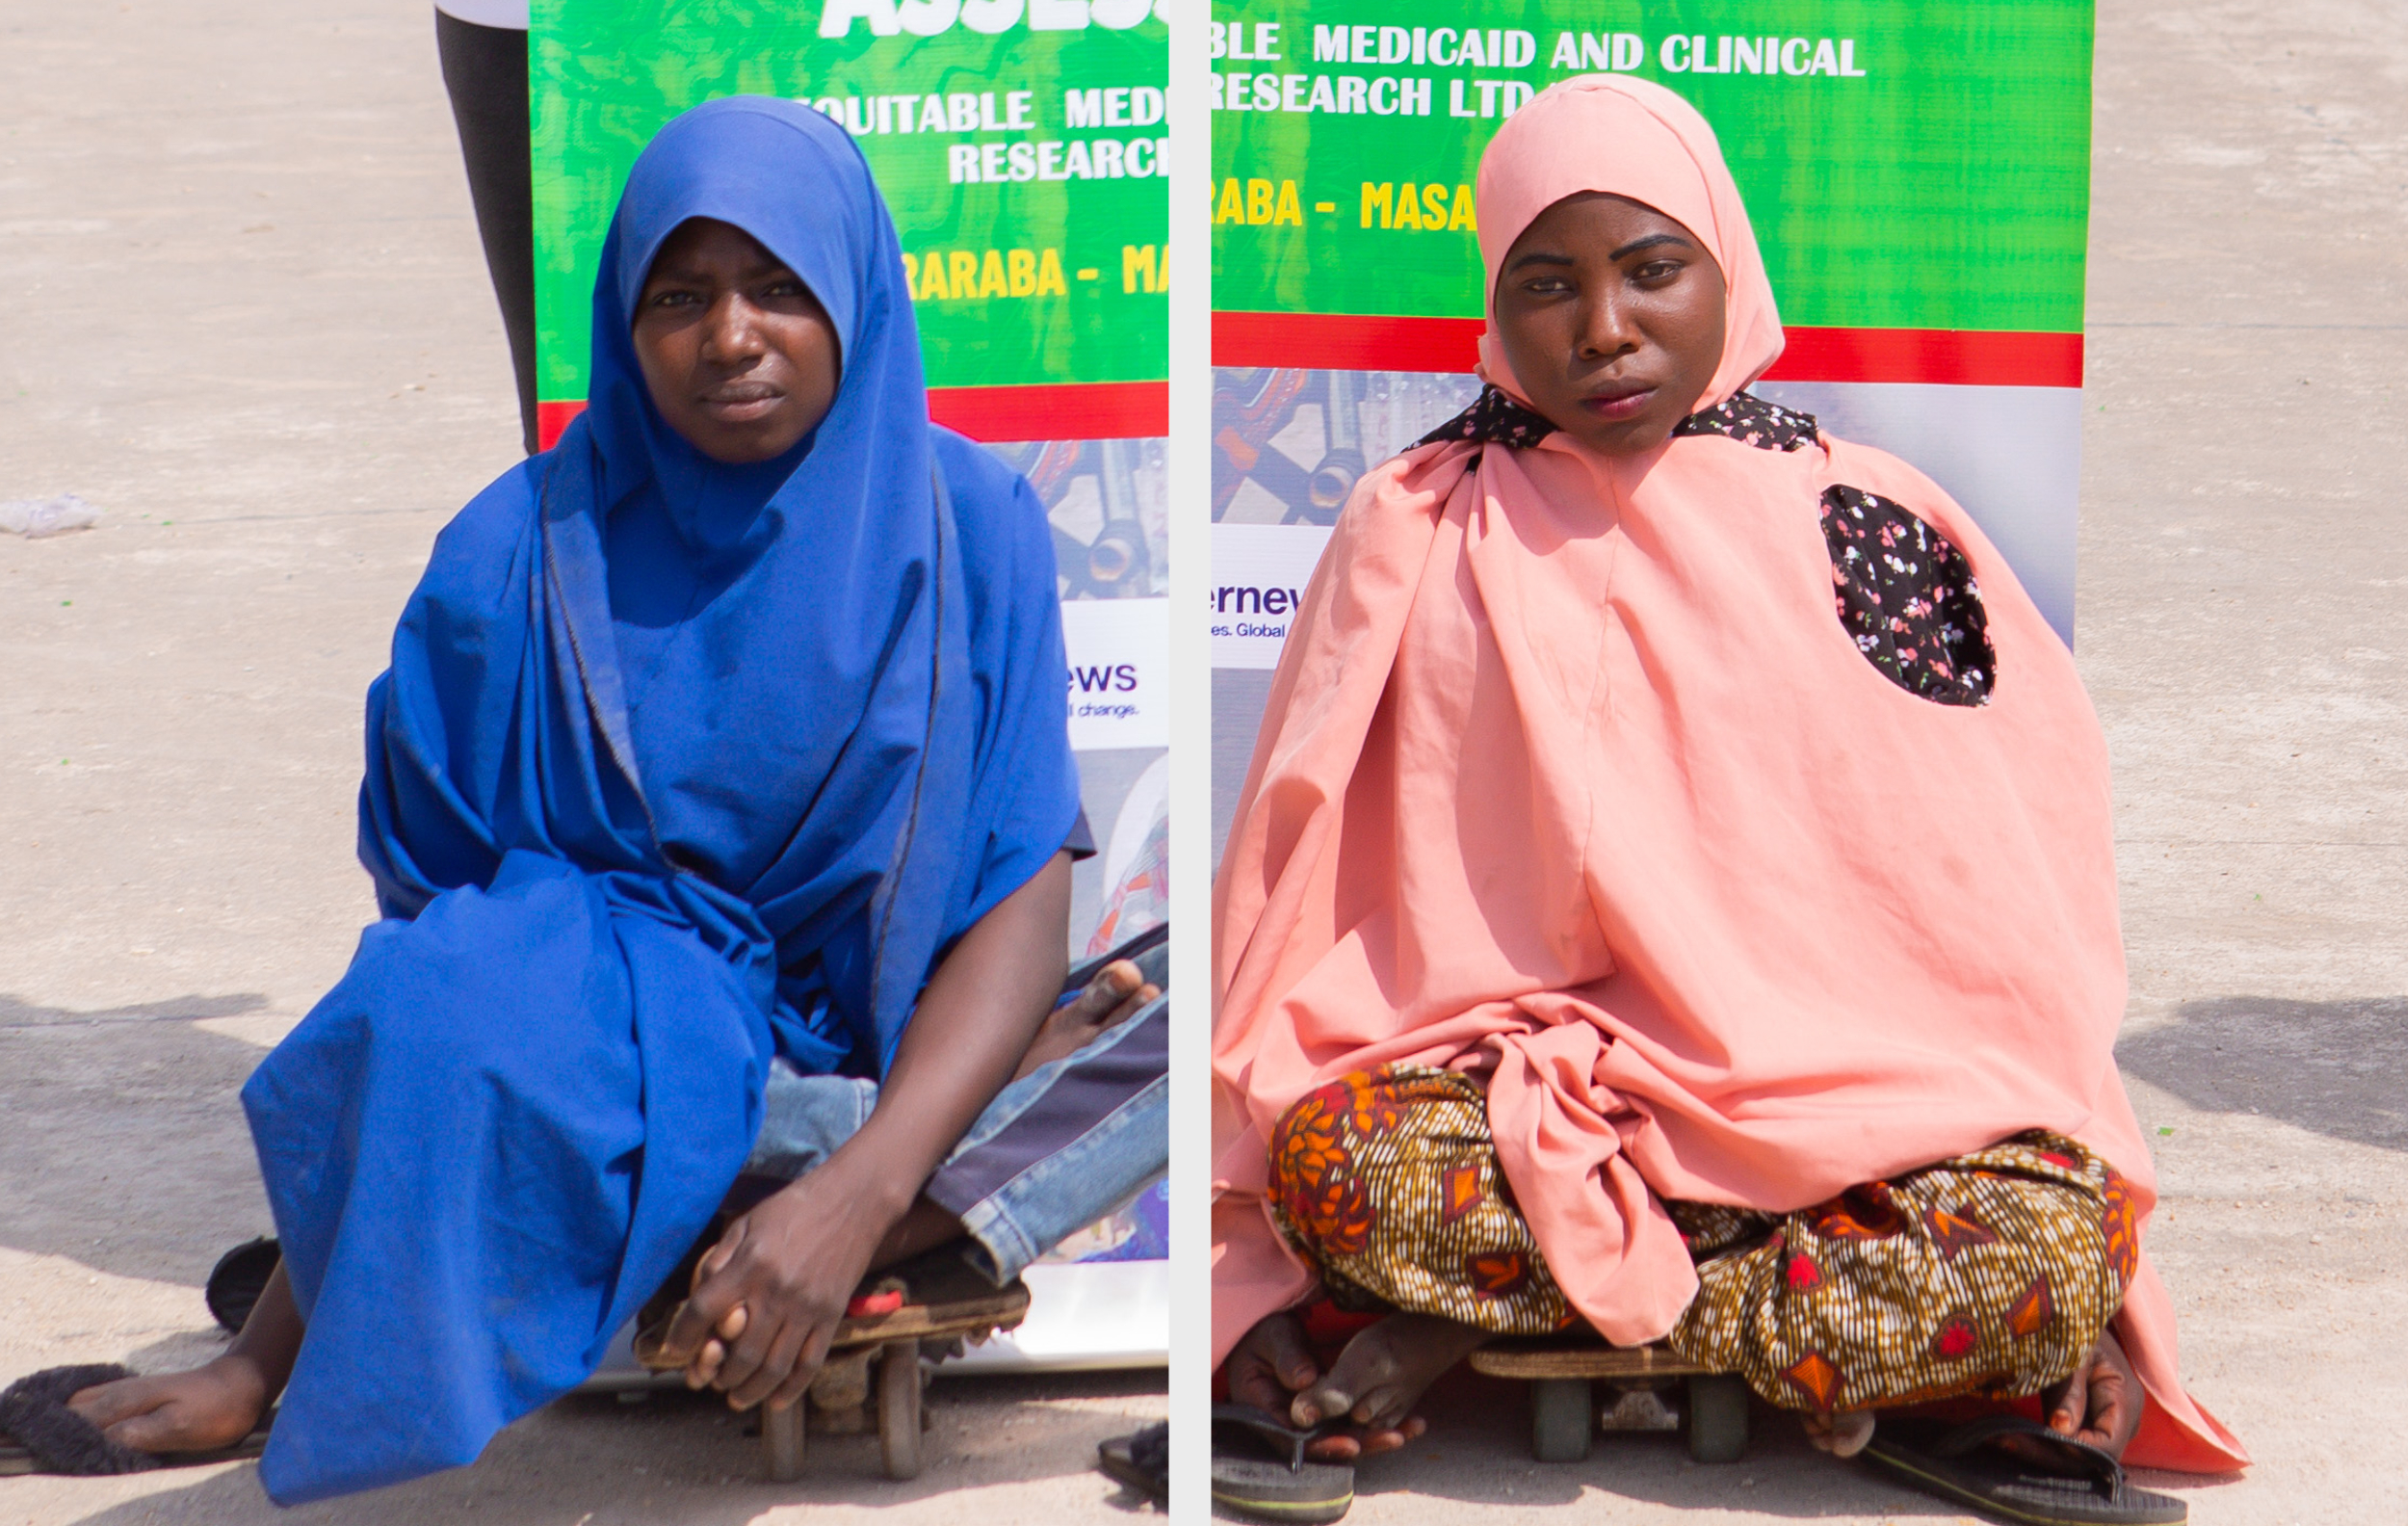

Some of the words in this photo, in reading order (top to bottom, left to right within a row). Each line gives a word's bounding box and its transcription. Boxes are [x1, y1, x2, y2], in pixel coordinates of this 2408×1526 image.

[1314, 24, 1536, 67] MEDICAID
[1550, 32, 1644, 71] AND
[1660, 34, 1867, 77] CLINICAL
[798, 91, 1035, 136] QUITABLE
[1450, 79, 1535, 118] LTD
[1211, 177, 1303, 226] ABA
[1360, 181, 1478, 231] MASA
[1236, 622, 1285, 638] Global
[1067, 664, 1138, 693] ws
